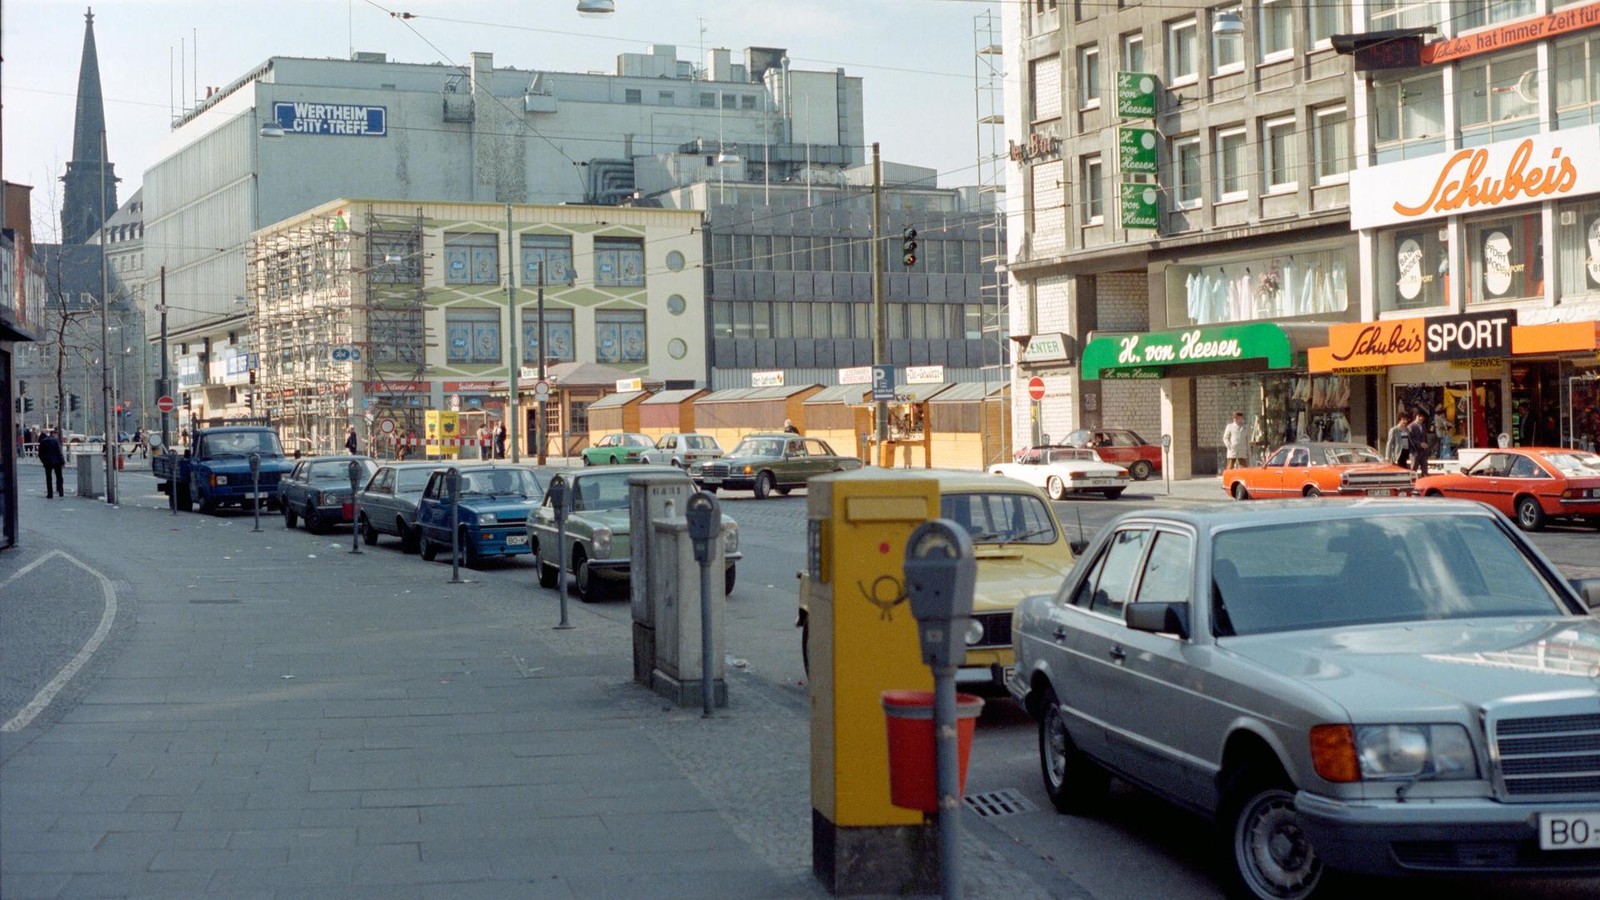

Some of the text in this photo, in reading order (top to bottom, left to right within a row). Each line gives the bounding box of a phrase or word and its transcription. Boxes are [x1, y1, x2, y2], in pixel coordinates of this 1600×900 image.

[1424, 39, 1471, 64] Schubeis
[1476, 33, 1497, 50] hat
[1501, 21, 1544, 42] immer
[1548, 10, 1576, 32] Zeit
[1579, 6, 1600, 25] für
[1118, 75, 1132, 88] H.
[1119, 91, 1137, 99] von
[293, 102, 368, 121] WERTHEIM
[1119, 101, 1154, 114] Heesen
[1120, 131, 1134, 144] H.
[1120, 146, 1139, 154] von
[1120, 156, 1156, 170] Heesen
[1393, 139, 1577, 217] Schubeis
[1121, 187, 1135, 199] H.
[1122, 202, 1140, 210] von
[1122, 212, 1157, 226] Heesen
[1118, 329, 1242, 364] H. von Heesen
[1332, 318, 1508, 361] Schubeis SPORT
[873, 368, 885, 388] P
[1550, 819, 1600, 845] BO-
